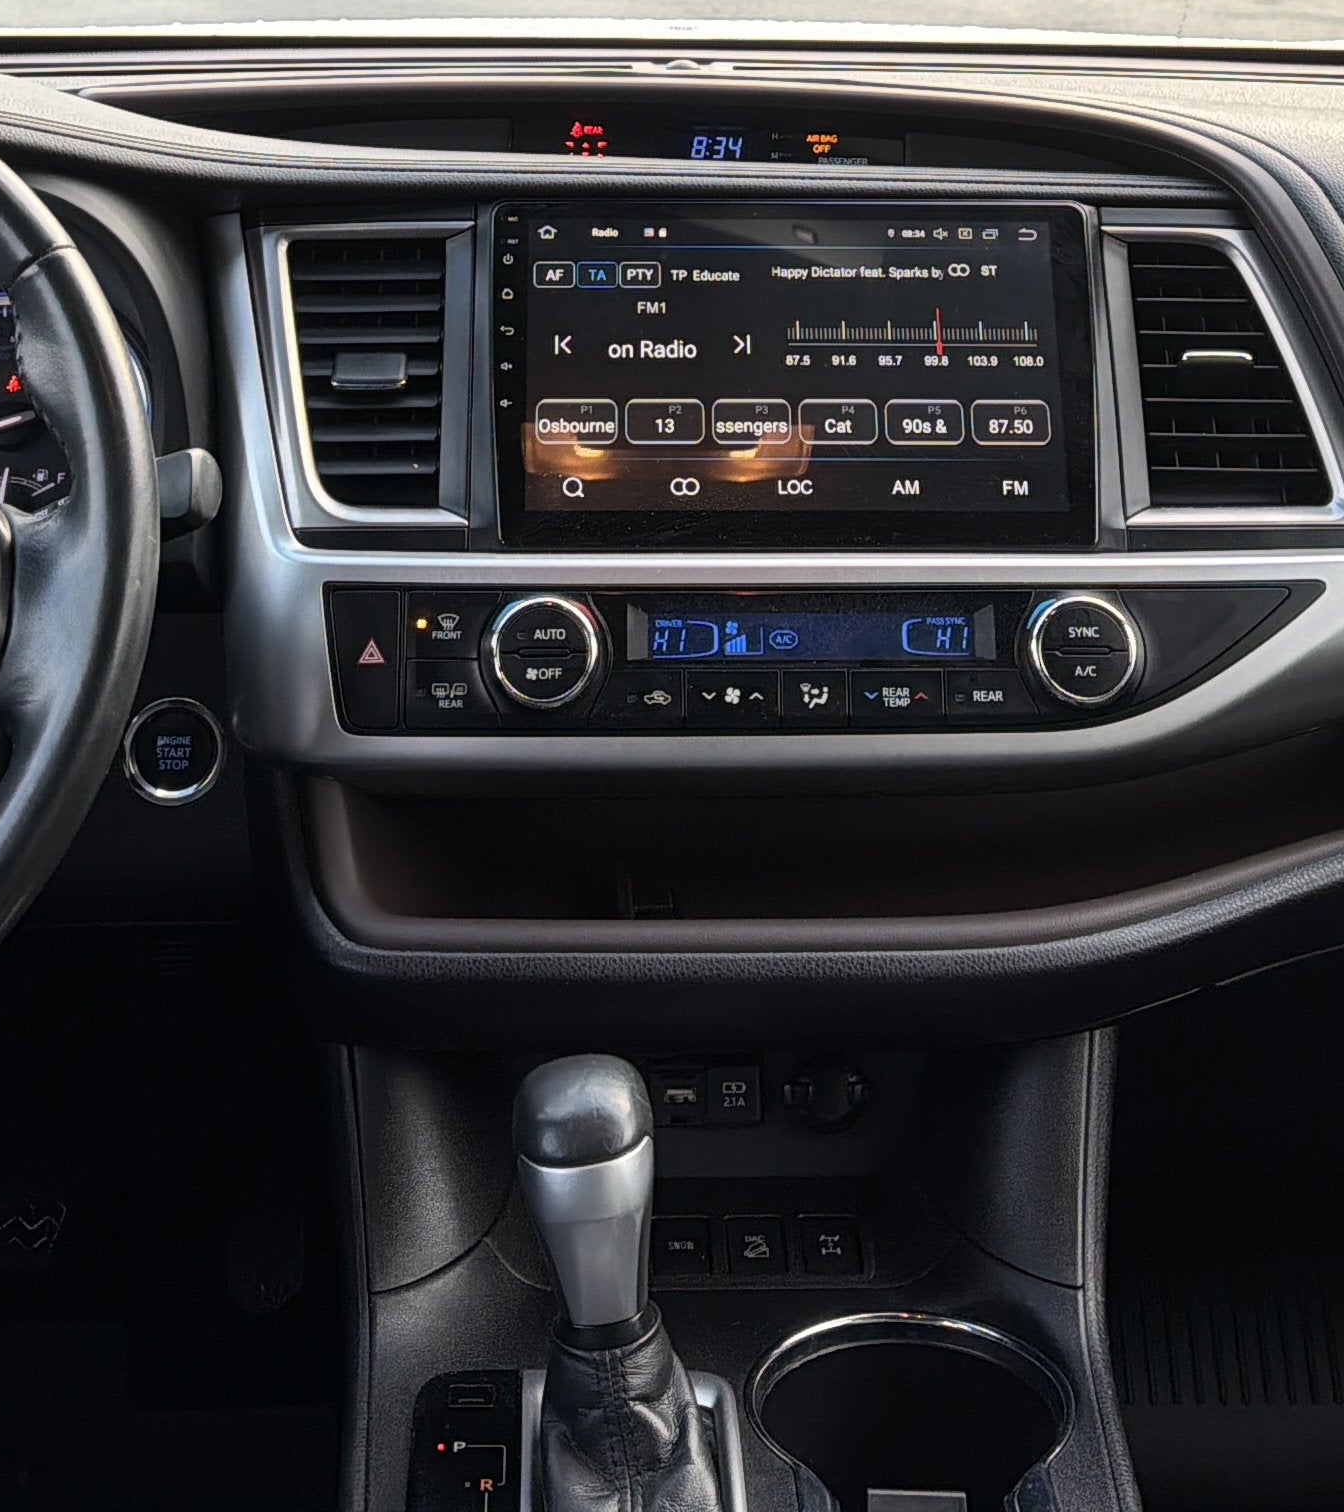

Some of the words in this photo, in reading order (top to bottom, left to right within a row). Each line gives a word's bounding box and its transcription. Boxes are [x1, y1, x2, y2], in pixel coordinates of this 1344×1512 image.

[806, 134, 819, 143] AIR
[821, 134, 838, 143] BAG
[691, 136, 742, 159] 8:34
[812, 144, 832, 154] OFF
[592, 228, 619, 237] Radio
[545, 269, 564, 281] AF
[589, 269, 606, 281] TA
[627, 268, 654, 281] PTY
[671, 269, 688, 282] TP
[693, 269, 741, 282] Educate
[771, 266, 809, 281] Happy
[811, 266, 857, 278] Dictator
[859, 266, 886, 278] feat.
[888, 266, 929, 279] Sparks
[981, 265, 997, 276] ST
[637, 302, 666, 314] FM1
[608, 344, 633, 359] on
[640, 340, 697, 359] Radio
[786, 355, 811, 367] 87.5
[831, 355, 856, 367] 91.6
[878, 355, 903, 367] 95.7
[924, 355, 949, 367] 99.8
[967, 355, 998, 367] 103.9
[1013, 355, 1044, 367] 108.0
[580, 405, 593, 415] P1
[668, 405, 682, 415] P2
[755, 405, 769, 415] P3
[841, 405, 855, 415] P4
[928, 405, 942, 415] P5
[1014, 405, 1027, 415] P6
[538, 418, 615, 434] Osbourne
[655, 418, 675, 434] 13
[716, 420, 788, 437] ssengers
[824, 419, 852, 434] Cat
[902, 419, 932, 434] 90s
[935, 420, 948, 434] &
[988, 419, 1034, 434] 87.50
[57, 472, 66, 484] F
[777, 480, 814, 495] LOC
[892, 480, 920, 495] AM
[1002, 480, 1028, 496] FM
[656, 619, 683, 628] DRIVER
[926, 617, 945, 625] PASS
[945, 617, 967, 625] SYNC
[432, 631, 462, 640] FRONT
[534, 629, 566, 640] AUTO
[1068, 626, 1100, 638] SYNC
[775, 635, 793, 644] A/C
[539, 668, 562, 680] OFF
[1075, 665, 1097, 677] A/C
[882, 687, 910, 696] REAR
[973, 691, 1003, 702] REAR
[438, 700, 463, 708] REAR
[883, 697, 911, 707] TEMP
[157, 736, 192, 746] ENGINE
[157, 748, 192, 758] START
[158, 760, 189, 770] STOP
[453, 1441, 466, 1453] P
[480, 1478, 494, 1491] R
